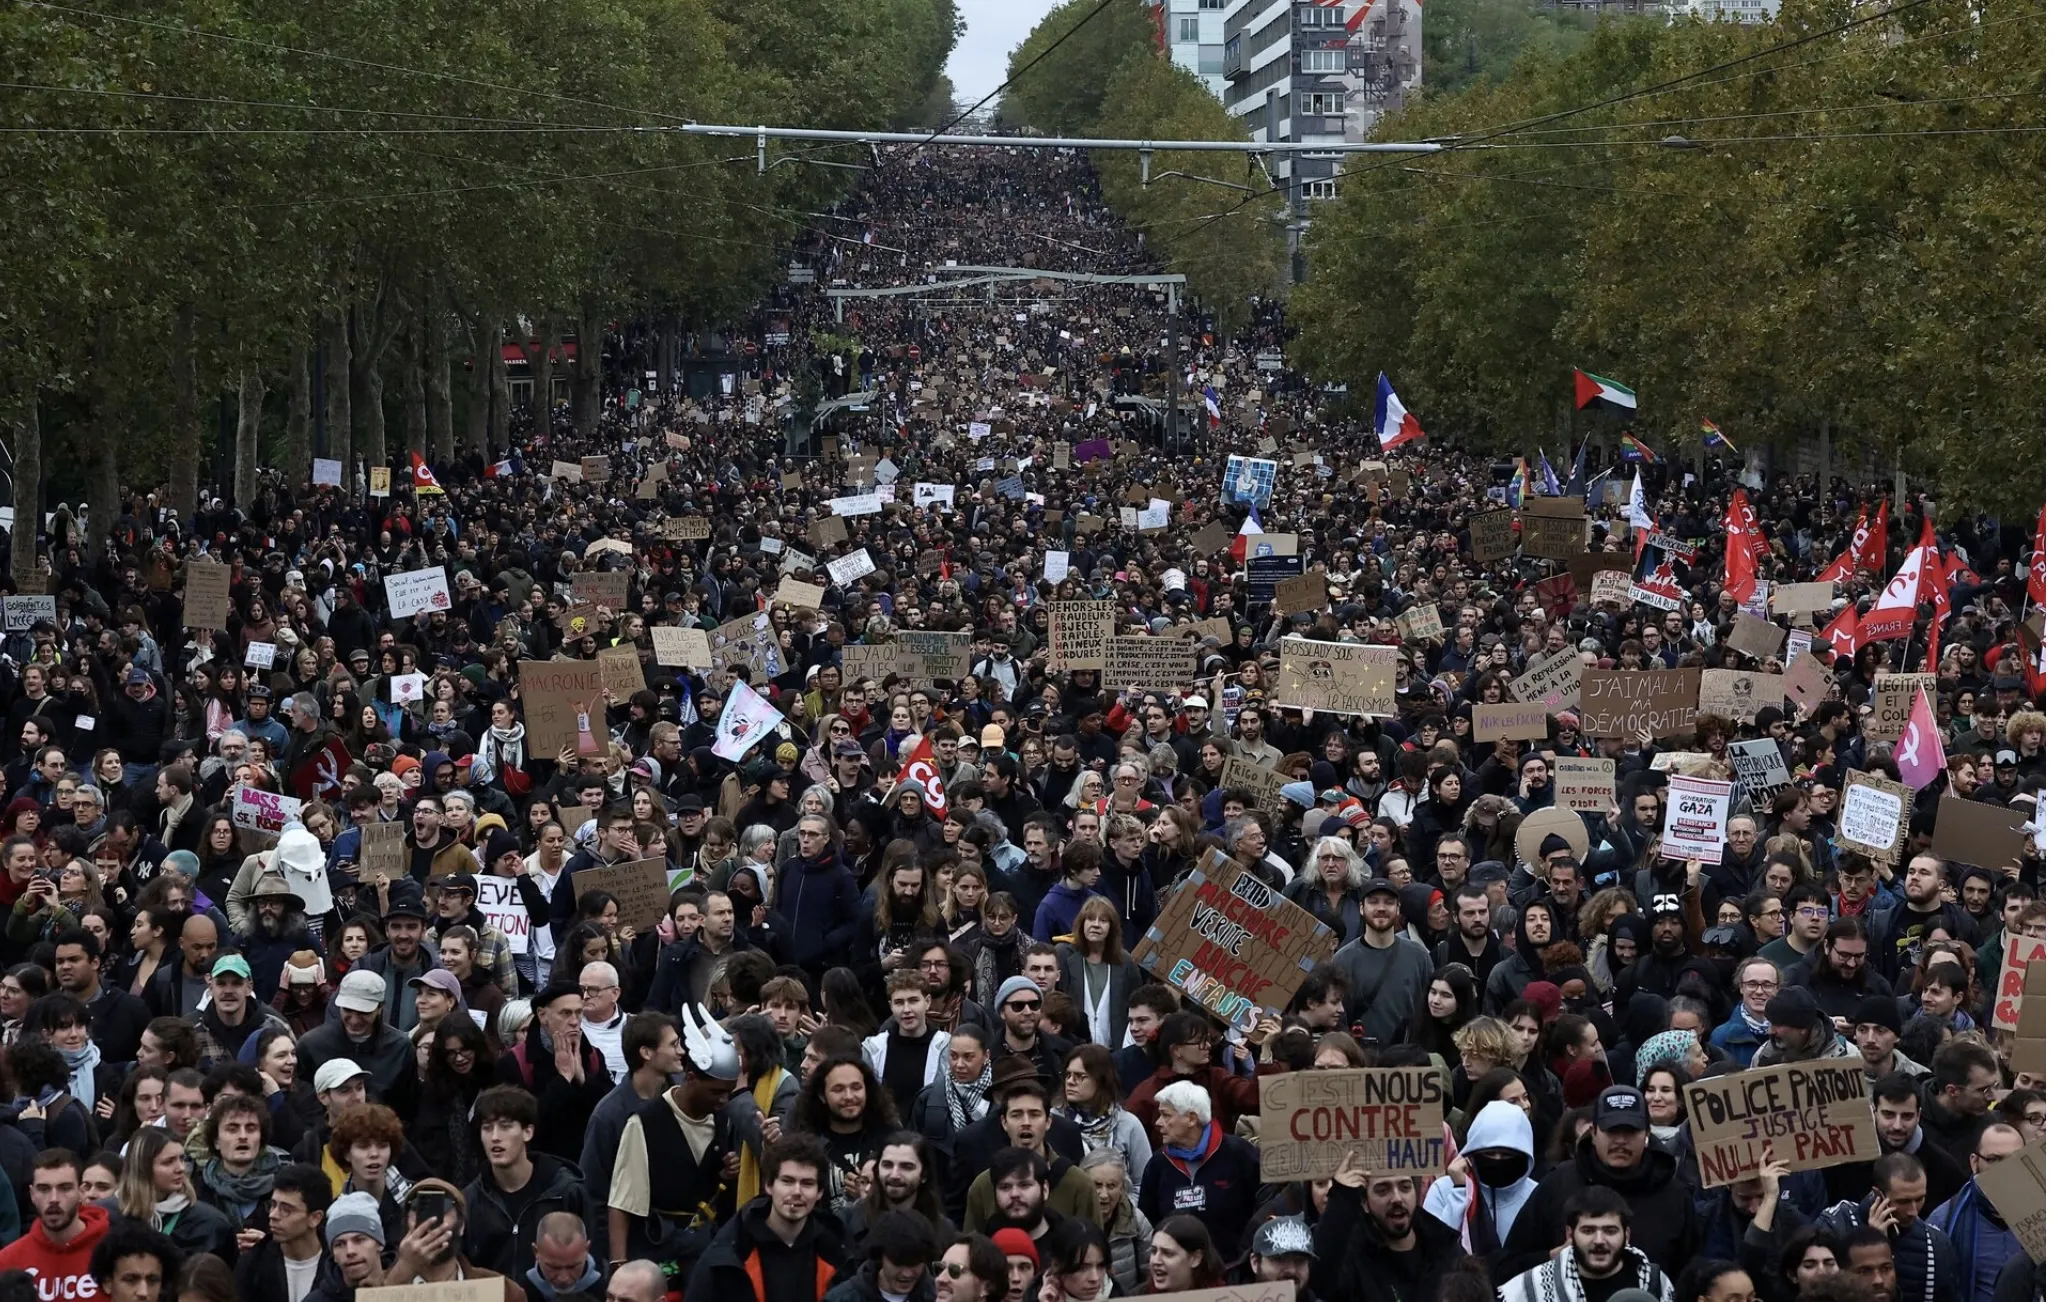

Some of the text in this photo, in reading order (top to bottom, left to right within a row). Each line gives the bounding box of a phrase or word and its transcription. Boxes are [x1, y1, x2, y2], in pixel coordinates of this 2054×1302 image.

[668, 528, 708, 538] METHOD
[1641, 591, 1655, 603] DANS
[1663, 599, 1679, 611] RUE
[1055, 612, 1112, 623] FRAUDEURS
[1055, 621, 1100, 633] ABJECTS
[1055, 630, 1106, 643] CRAPULES
[1055, 639, 1102, 651] HAINEUX
[1056, 650, 1102, 660] ORDURES
[1334, 647, 1353, 660] SOUS
[1169, 661, 1189, 669] VOUS
[522, 671, 604, 692] MACRONIE
[1560, 669, 1571, 682] LA
[1517, 681, 1530, 693] LA
[1589, 676, 1633, 699] J'AI
[1636, 676, 1669, 697] MAL
[1630, 698, 1652, 711] MA
[1583, 706, 1695, 734] DÉMOCRATIE
[1731, 744, 1753, 758] LA
[1735, 751, 1784, 774] RÉPUBLIQUE
[1742, 772, 1769, 790] C'EST
[1561, 785, 1612, 796] LES FORCES
[1569, 800, 1599, 809] ORDRE
[1678, 801, 1713, 818] GAZA
[235, 811, 251, 823] SE
[1167, 958, 1264, 1034] ENFANTS
[1365, 1071, 1443, 1106] NOUS
[1689, 1067, 1866, 1132] POLICE PARTOUT
[1290, 1105, 1422, 1143] CONTRE
[1741, 1106, 1831, 1140] JUSTICE
[1386, 1138, 1444, 1170] HAUT
[1701, 1124, 1857, 1186] NULLE PART
